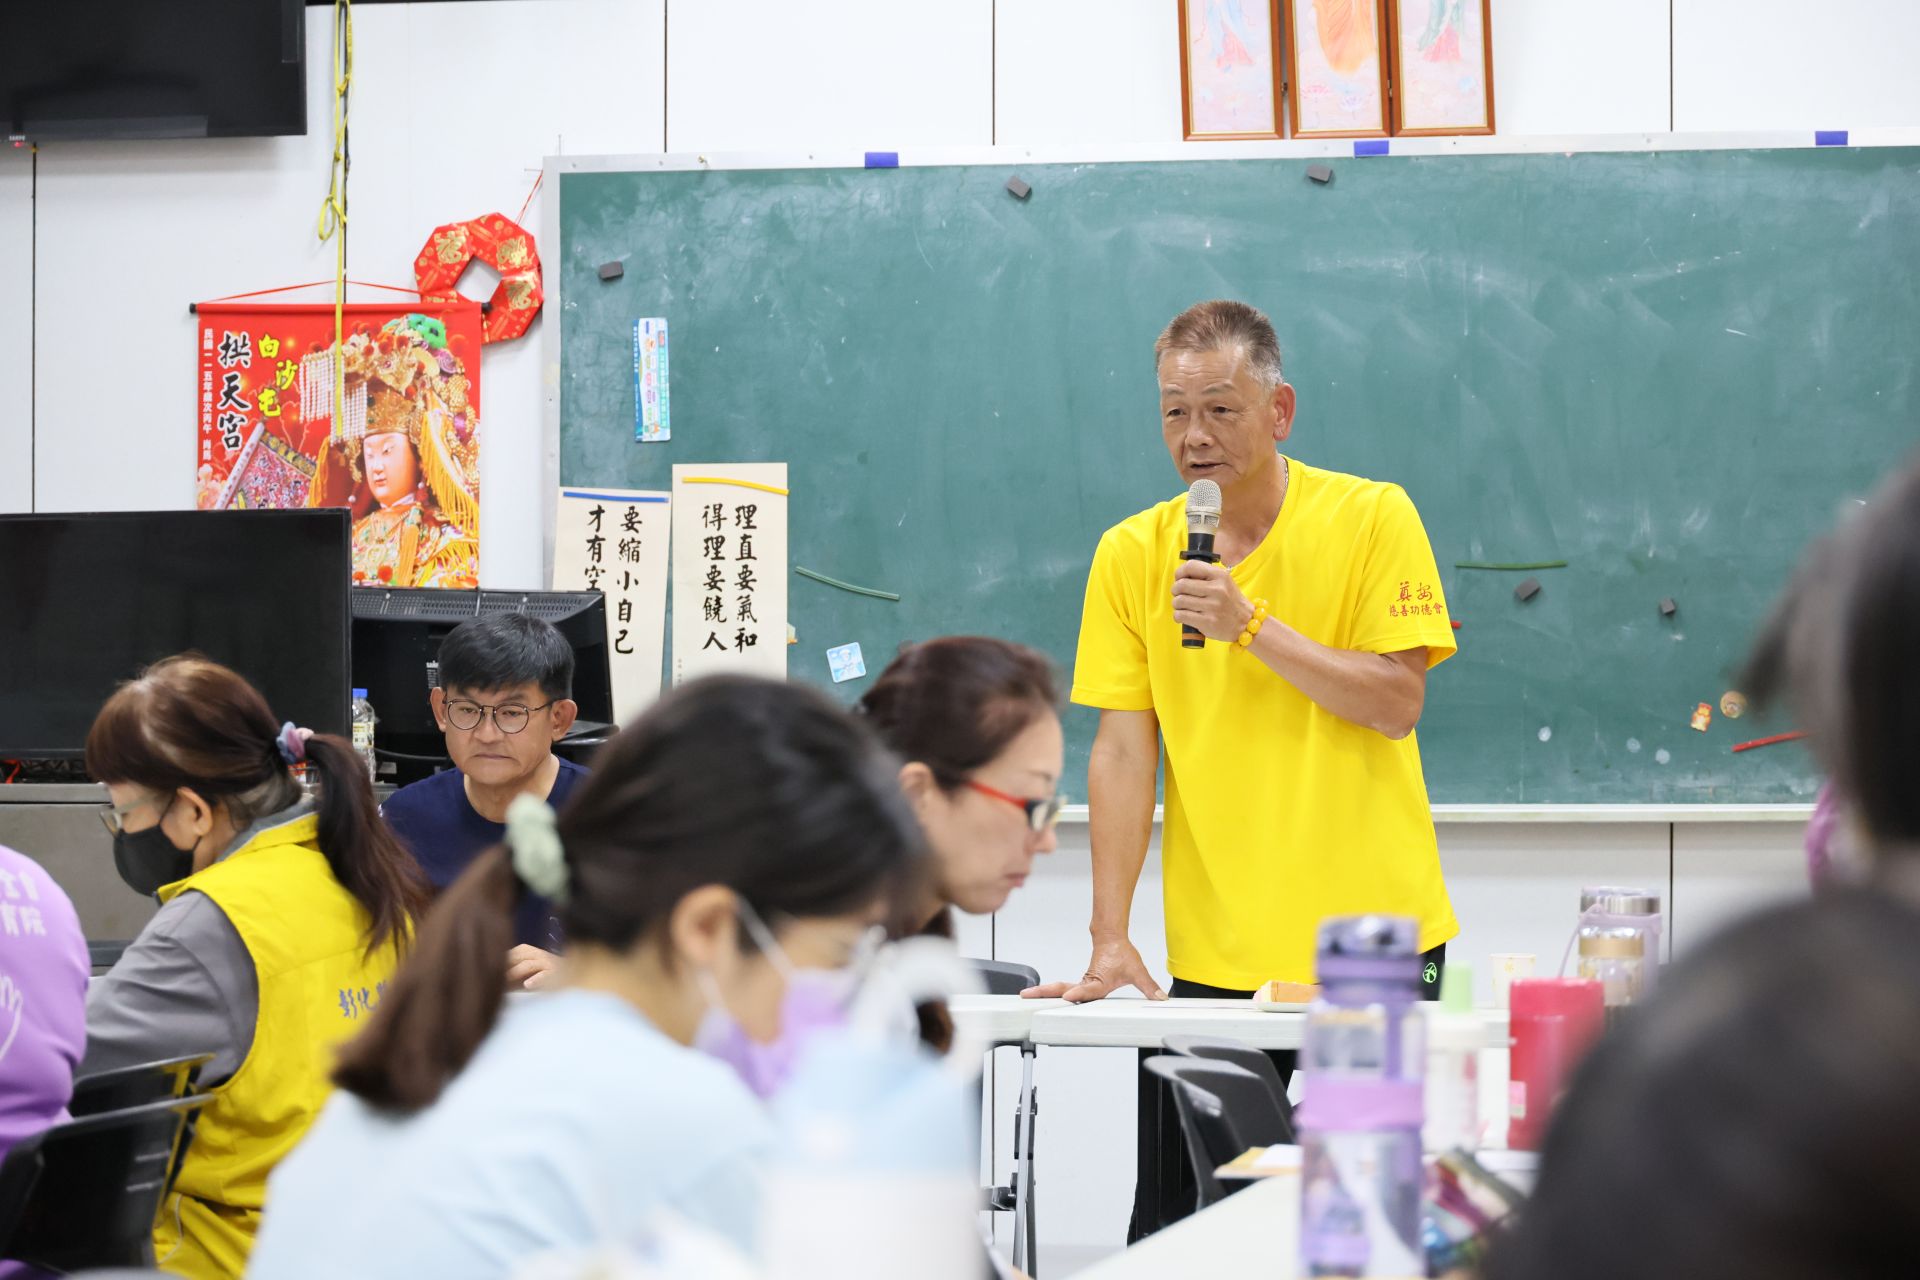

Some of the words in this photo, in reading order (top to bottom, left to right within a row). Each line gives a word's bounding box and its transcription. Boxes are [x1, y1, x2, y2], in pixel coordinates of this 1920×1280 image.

[217, 330, 252, 451] 拱天宮
[257, 333, 298, 417] 白沙屯
[584, 504, 606, 591] 才有空
[614, 505, 643, 654] 要縮小自己
[701, 503, 728, 651] 得理要饒人
[734, 503, 758, 653] 理直要氣和
[1389, 603, 1443, 617] 慈善功德會
